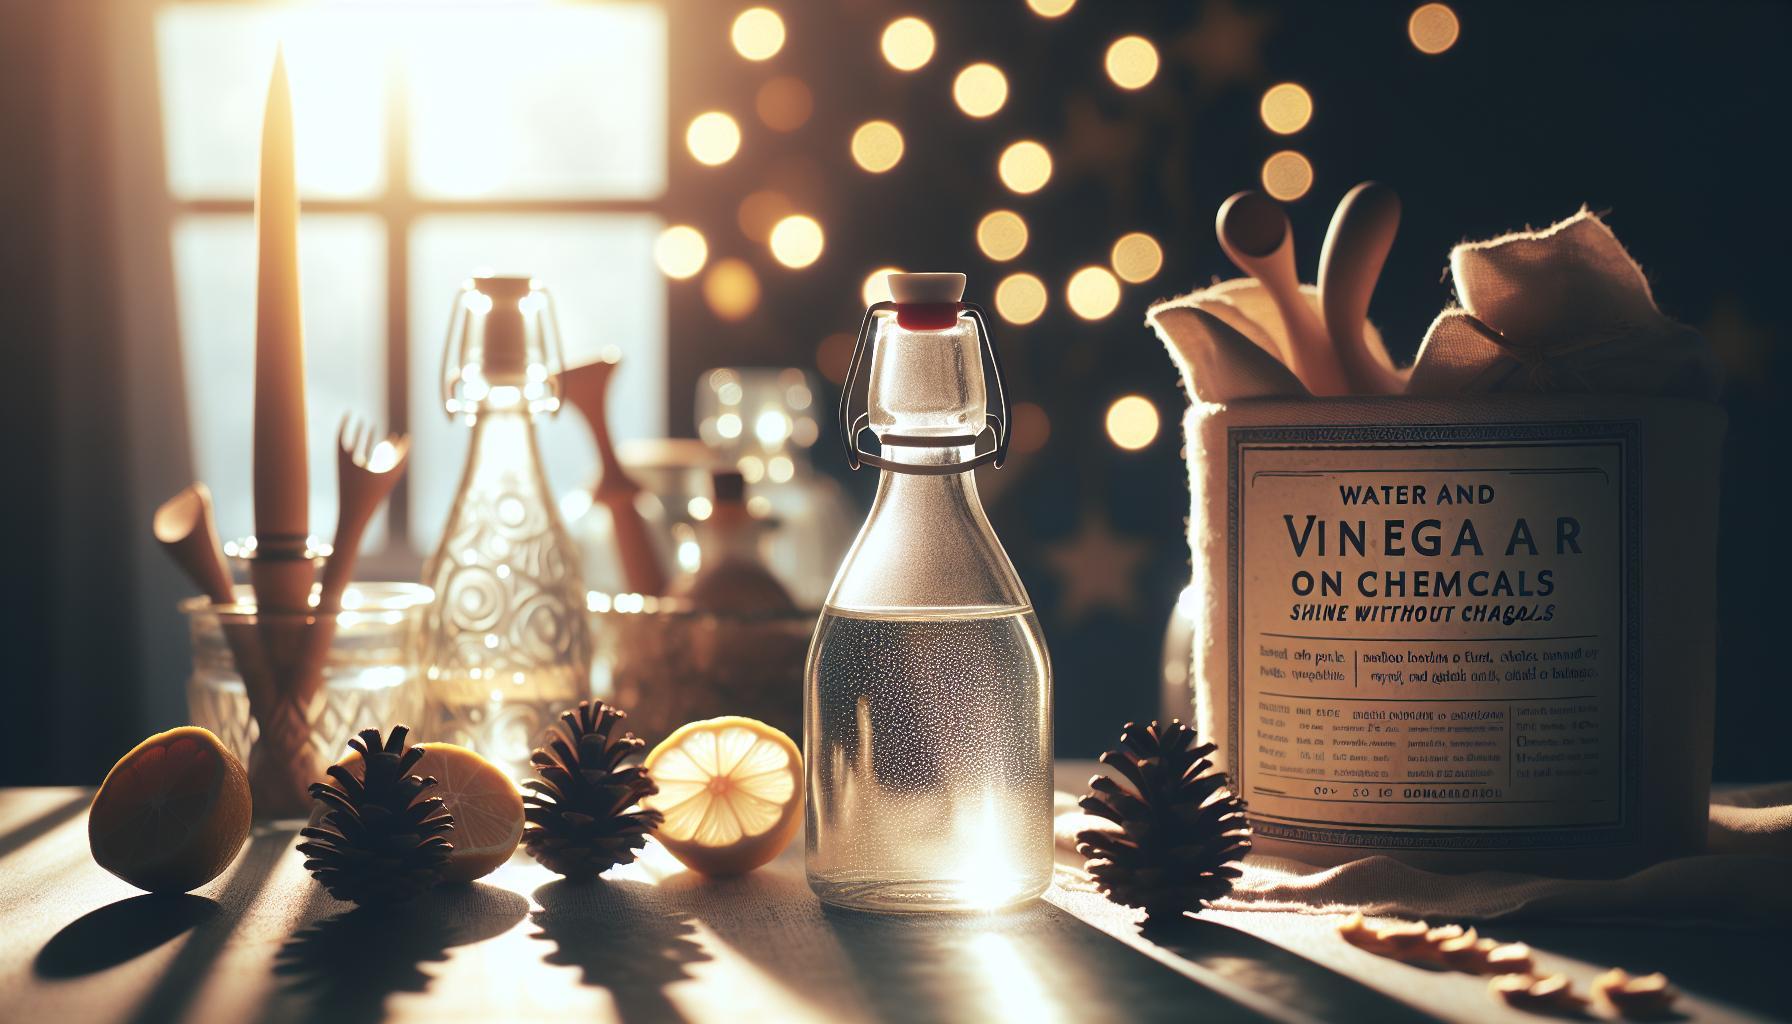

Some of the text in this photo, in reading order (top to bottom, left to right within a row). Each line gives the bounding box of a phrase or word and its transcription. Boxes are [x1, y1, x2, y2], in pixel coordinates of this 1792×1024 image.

[1339, 484, 1495, 506] WATER AND
[1291, 569, 1555, 598] ON CHEMCALS
[1290, 603, 1348, 622] SHINE
